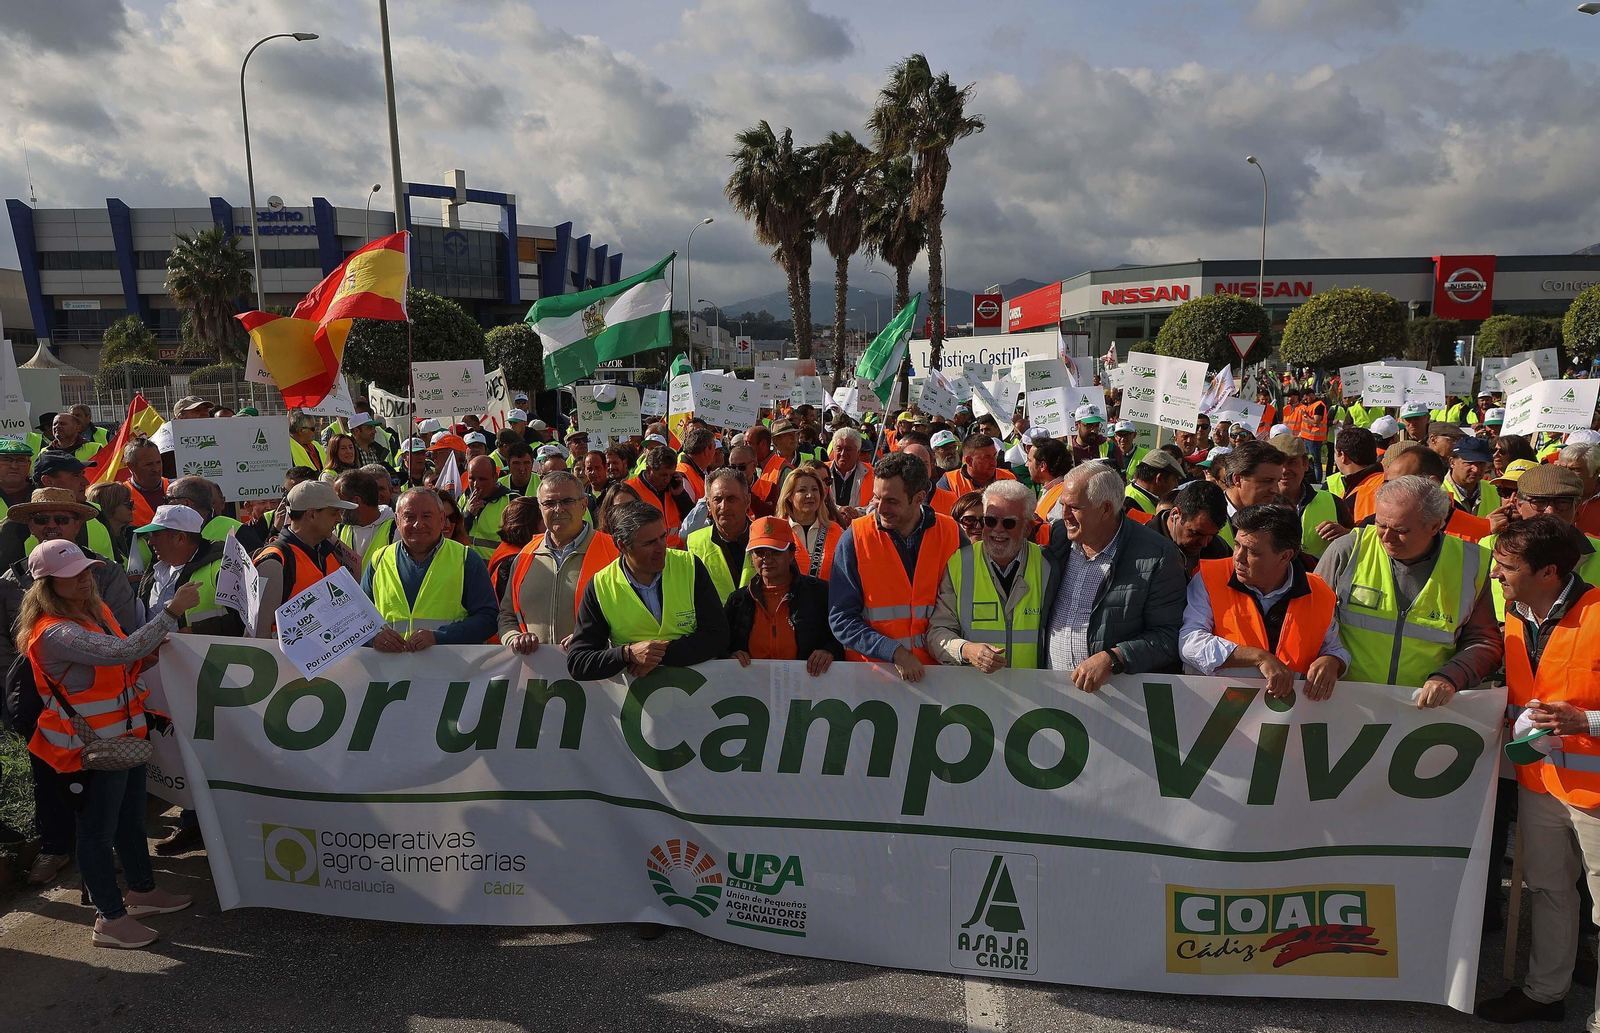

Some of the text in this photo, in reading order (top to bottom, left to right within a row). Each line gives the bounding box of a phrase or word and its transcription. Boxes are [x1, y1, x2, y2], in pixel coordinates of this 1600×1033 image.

[235, 225, 317, 236] DE NEGOCIOS
[1214, 281, 1313, 298] NISSAN
[1449, 282, 1484, 290] NISSAN
[1102, 284, 1189, 305] NISSAN
[257, 369, 270, 378] Por
[1028, 370, 1050, 378] COAG
[1131, 365, 1156, 374] COAG
[1032, 397, 1056, 407] COAG
[453, 406, 473, 414] Campo
[1128, 408, 1139, 417] Por
[1, 418, 25, 429] Vivo
[724, 418, 741, 428] Campo
[1159, 414, 1194, 429] Campo Vivo
[1536, 422, 1566, 431] Campo
[180, 434, 216, 445] COAG
[203, 460, 222, 469] UPA
[238, 485, 270, 497] Campo
[58, 547, 82, 558] FILA
[280, 591, 317, 618] COAG
[297, 612, 316, 627] UPA
[305, 657, 321, 672] Por
[321, 650, 332, 662] un
[331, 632, 360, 655] Campo
[193, 643, 411, 752] Por
[435, 678, 587, 753] un
[620, 665, 1090, 817] Campo
[1142, 682, 1485, 806] Vivo
[321, 830, 476, 852] cooperativas
[322, 851, 527, 874] agro-alimentarias
[727, 851, 804, 891] UPA
[324, 876, 525, 896] Andalucía Cádiz
[728, 880, 759, 892] CÁDIZ
[726, 890, 807, 909] Unión de Pequeños
[725, 899, 807, 920] AGRICULTORES
[1180, 893, 1362, 932] COAG
[736, 911, 805, 930] GANADEROS
[957, 932, 1029, 956] ASAJA
[1176, 938, 1257, 962] Cádiz
[976, 952, 1029, 971] CADIZ
